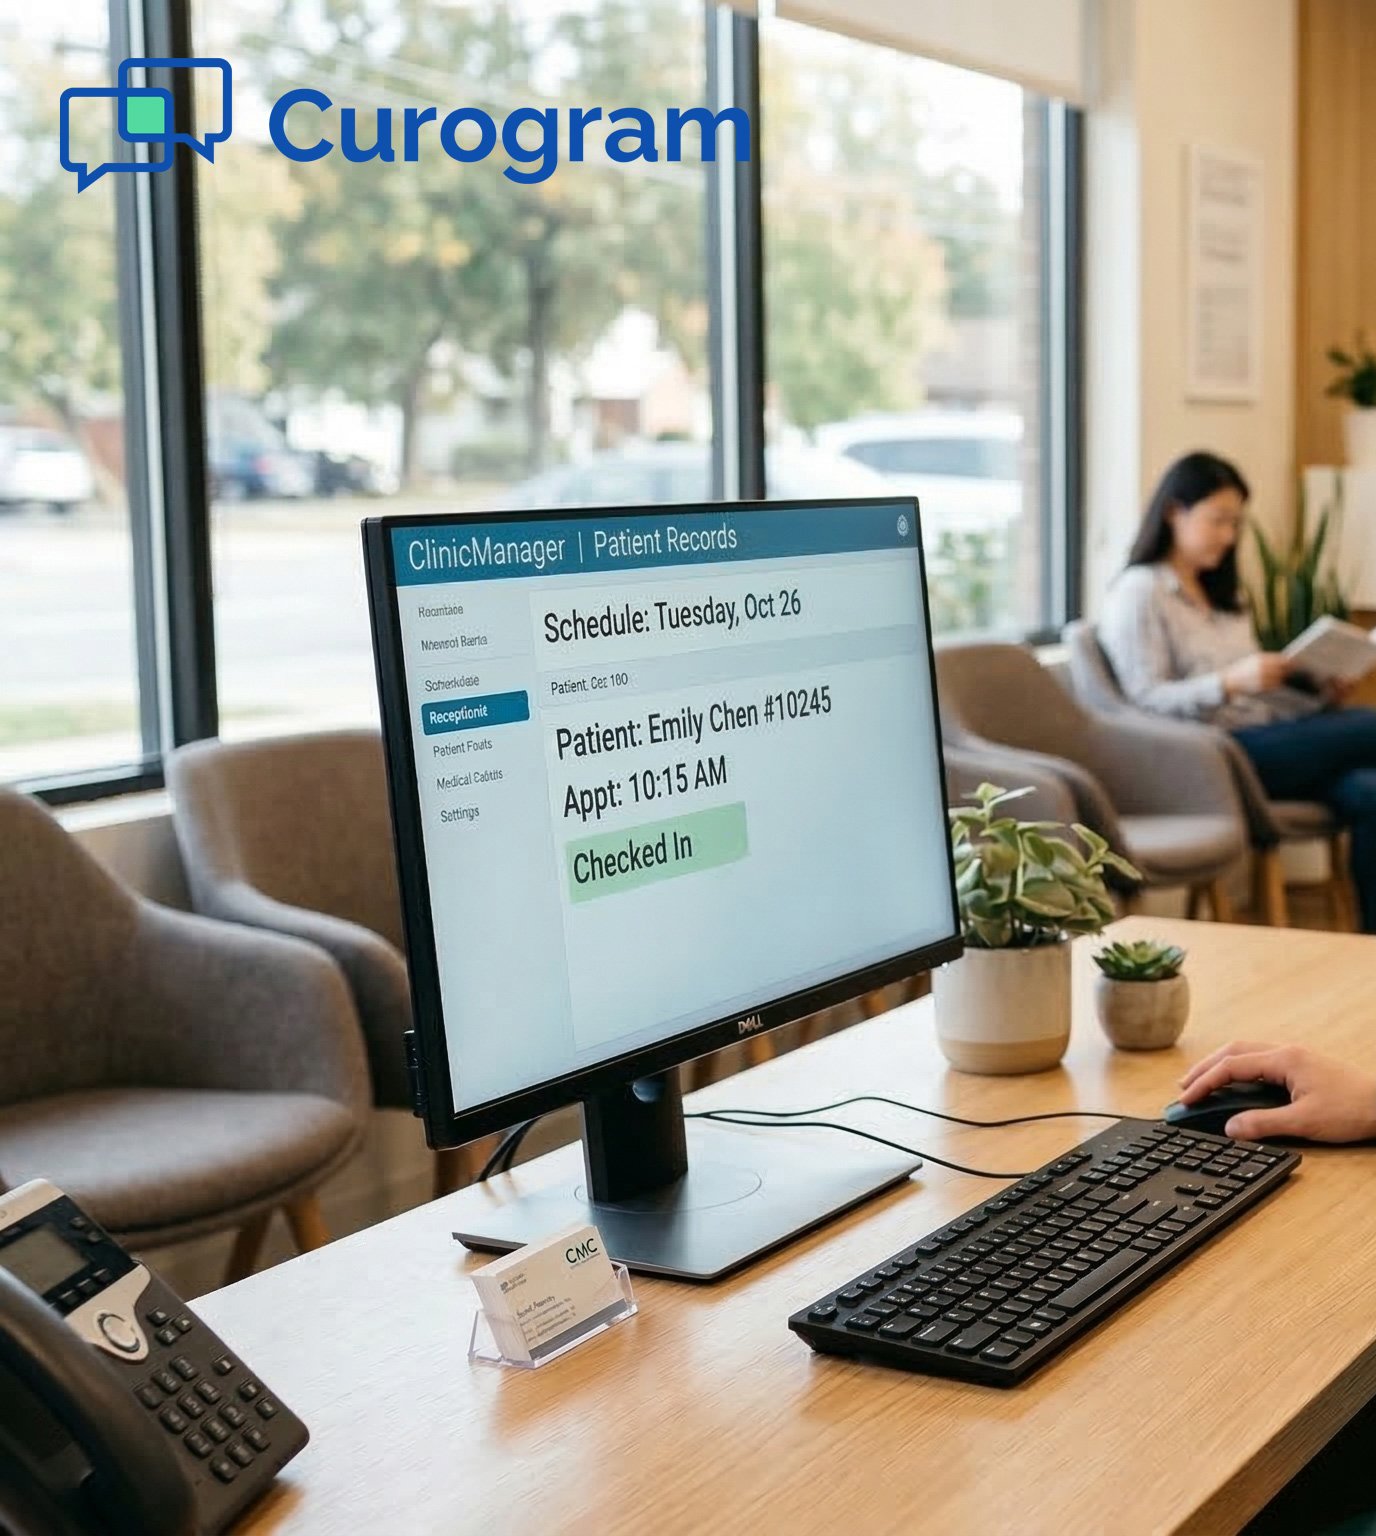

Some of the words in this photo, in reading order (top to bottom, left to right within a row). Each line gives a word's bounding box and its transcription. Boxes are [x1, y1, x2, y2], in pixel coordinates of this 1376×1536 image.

[409, 536, 565, 570] ClinicManager
[594, 528, 662, 558] Patient
[667, 522, 737, 553] Records
[544, 603, 650, 643] Schedule:
[654, 596, 740, 631] Tuesday,
[744, 593, 775, 620] Oct
[779, 588, 801, 616] 26
[556, 719, 643, 760] Patient:
[648, 706, 703, 745] Emily
[710, 701, 758, 733] Chen
[764, 685, 832, 723] #10245
[433, 742, 465, 758] Patient
[563, 778, 623, 821] Appt:
[628, 763, 688, 802] 10:15
[694, 755, 727, 789] AM
[573, 832, 667, 884] Checked
[673, 831, 692, 861] In
[566, 1238, 598, 1264] CMC
